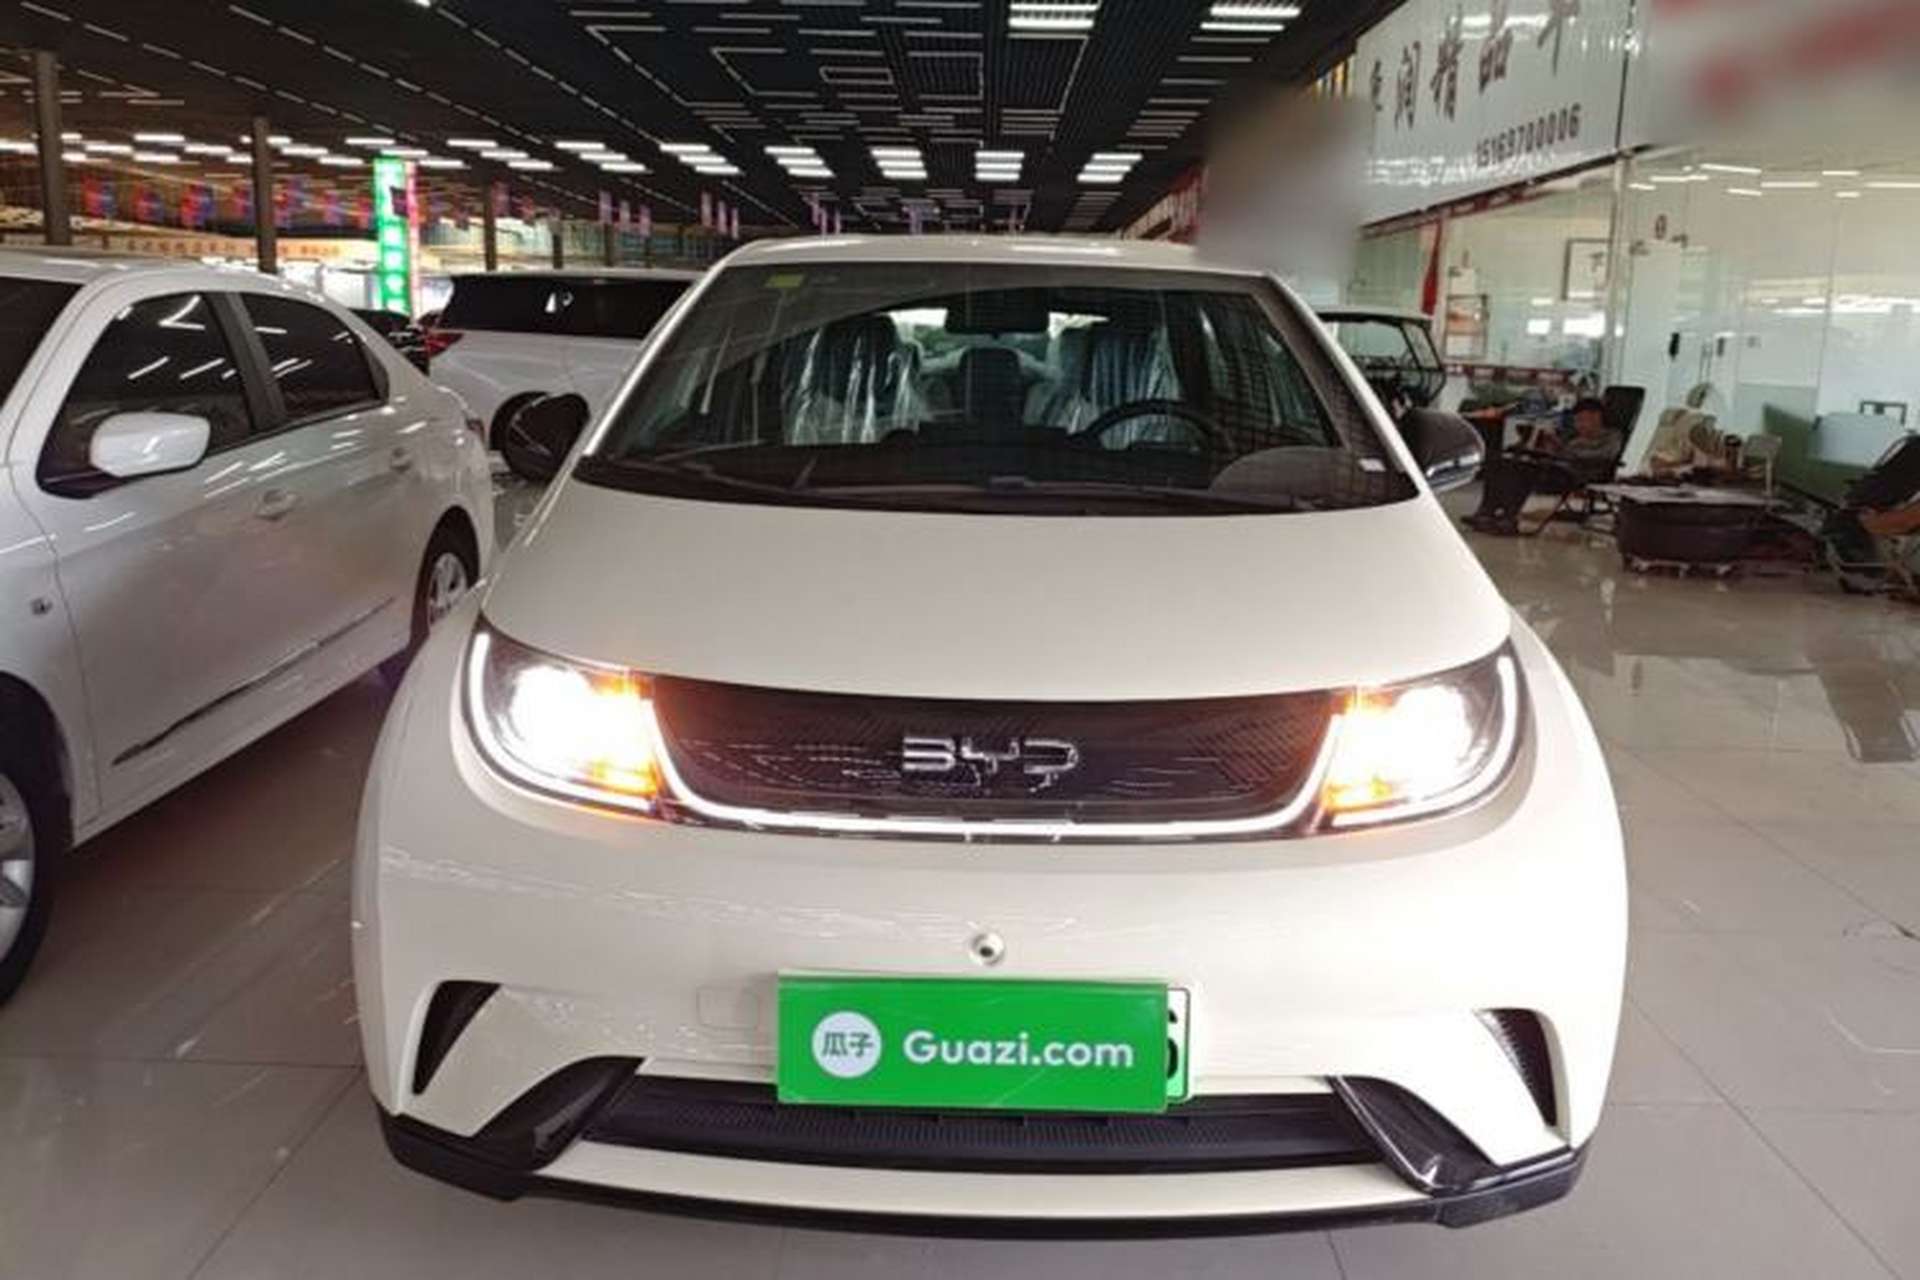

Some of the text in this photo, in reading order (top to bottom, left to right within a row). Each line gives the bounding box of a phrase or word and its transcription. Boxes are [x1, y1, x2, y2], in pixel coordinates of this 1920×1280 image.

[902, 735, 1079, 777] BYD
[821, 1030, 875, 1060] 瓜子
[902, 1029, 1135, 1068] Guazi.com
